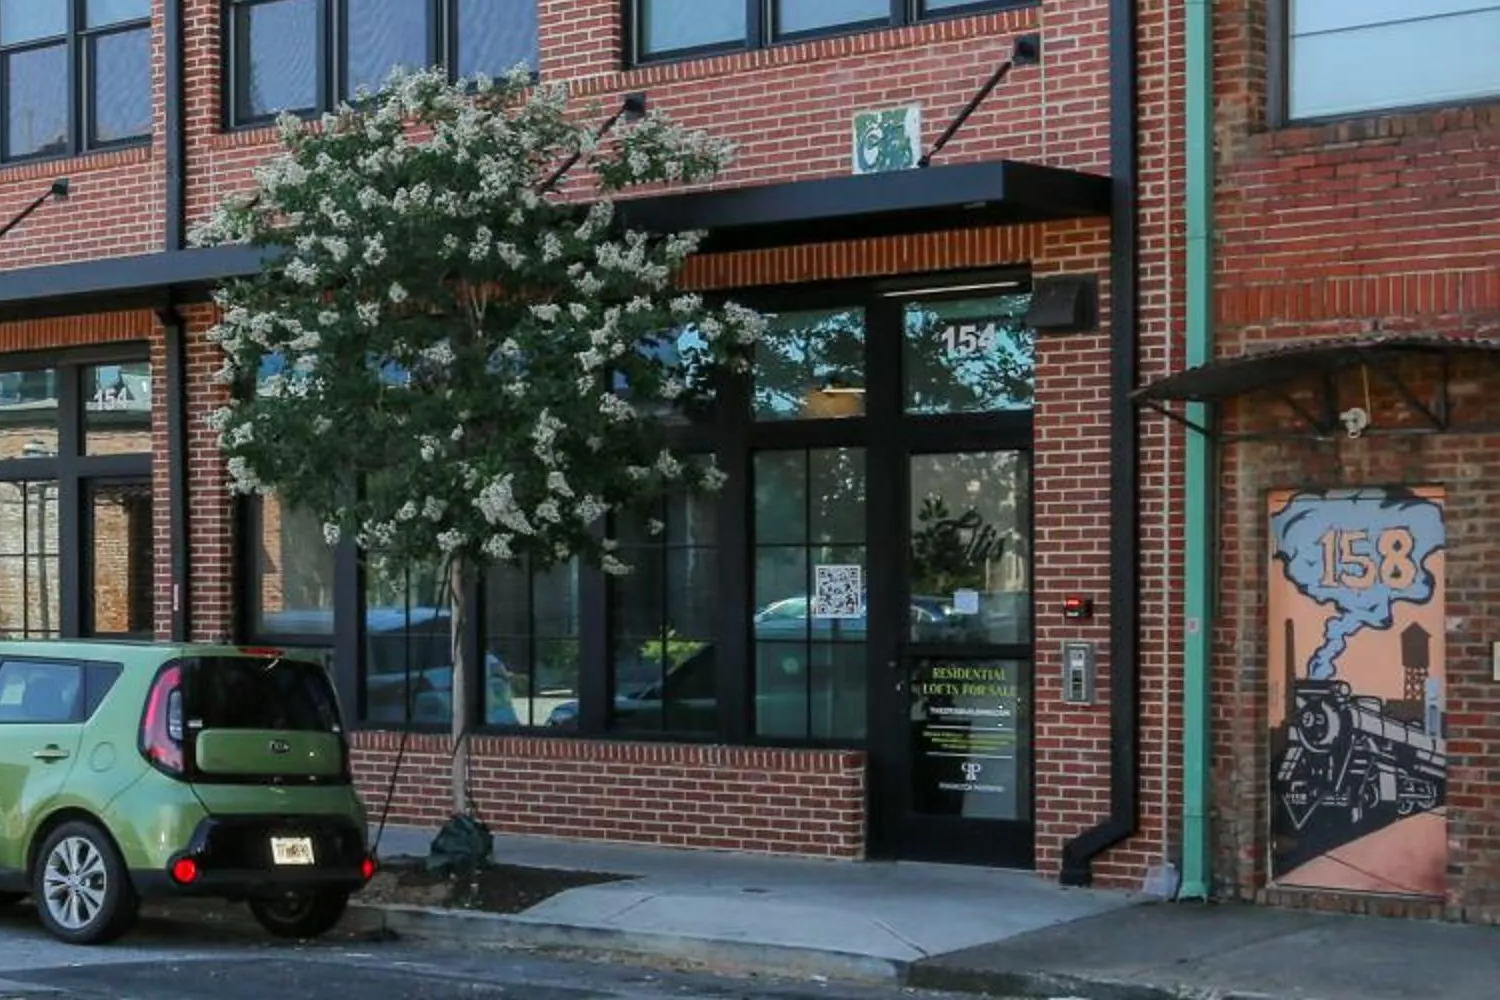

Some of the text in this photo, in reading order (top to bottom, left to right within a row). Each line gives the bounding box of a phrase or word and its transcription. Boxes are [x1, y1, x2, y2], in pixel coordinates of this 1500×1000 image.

[941, 323, 996, 356] 154
[93, 387, 128, 412] 154
[1314, 525, 1418, 590] 158
